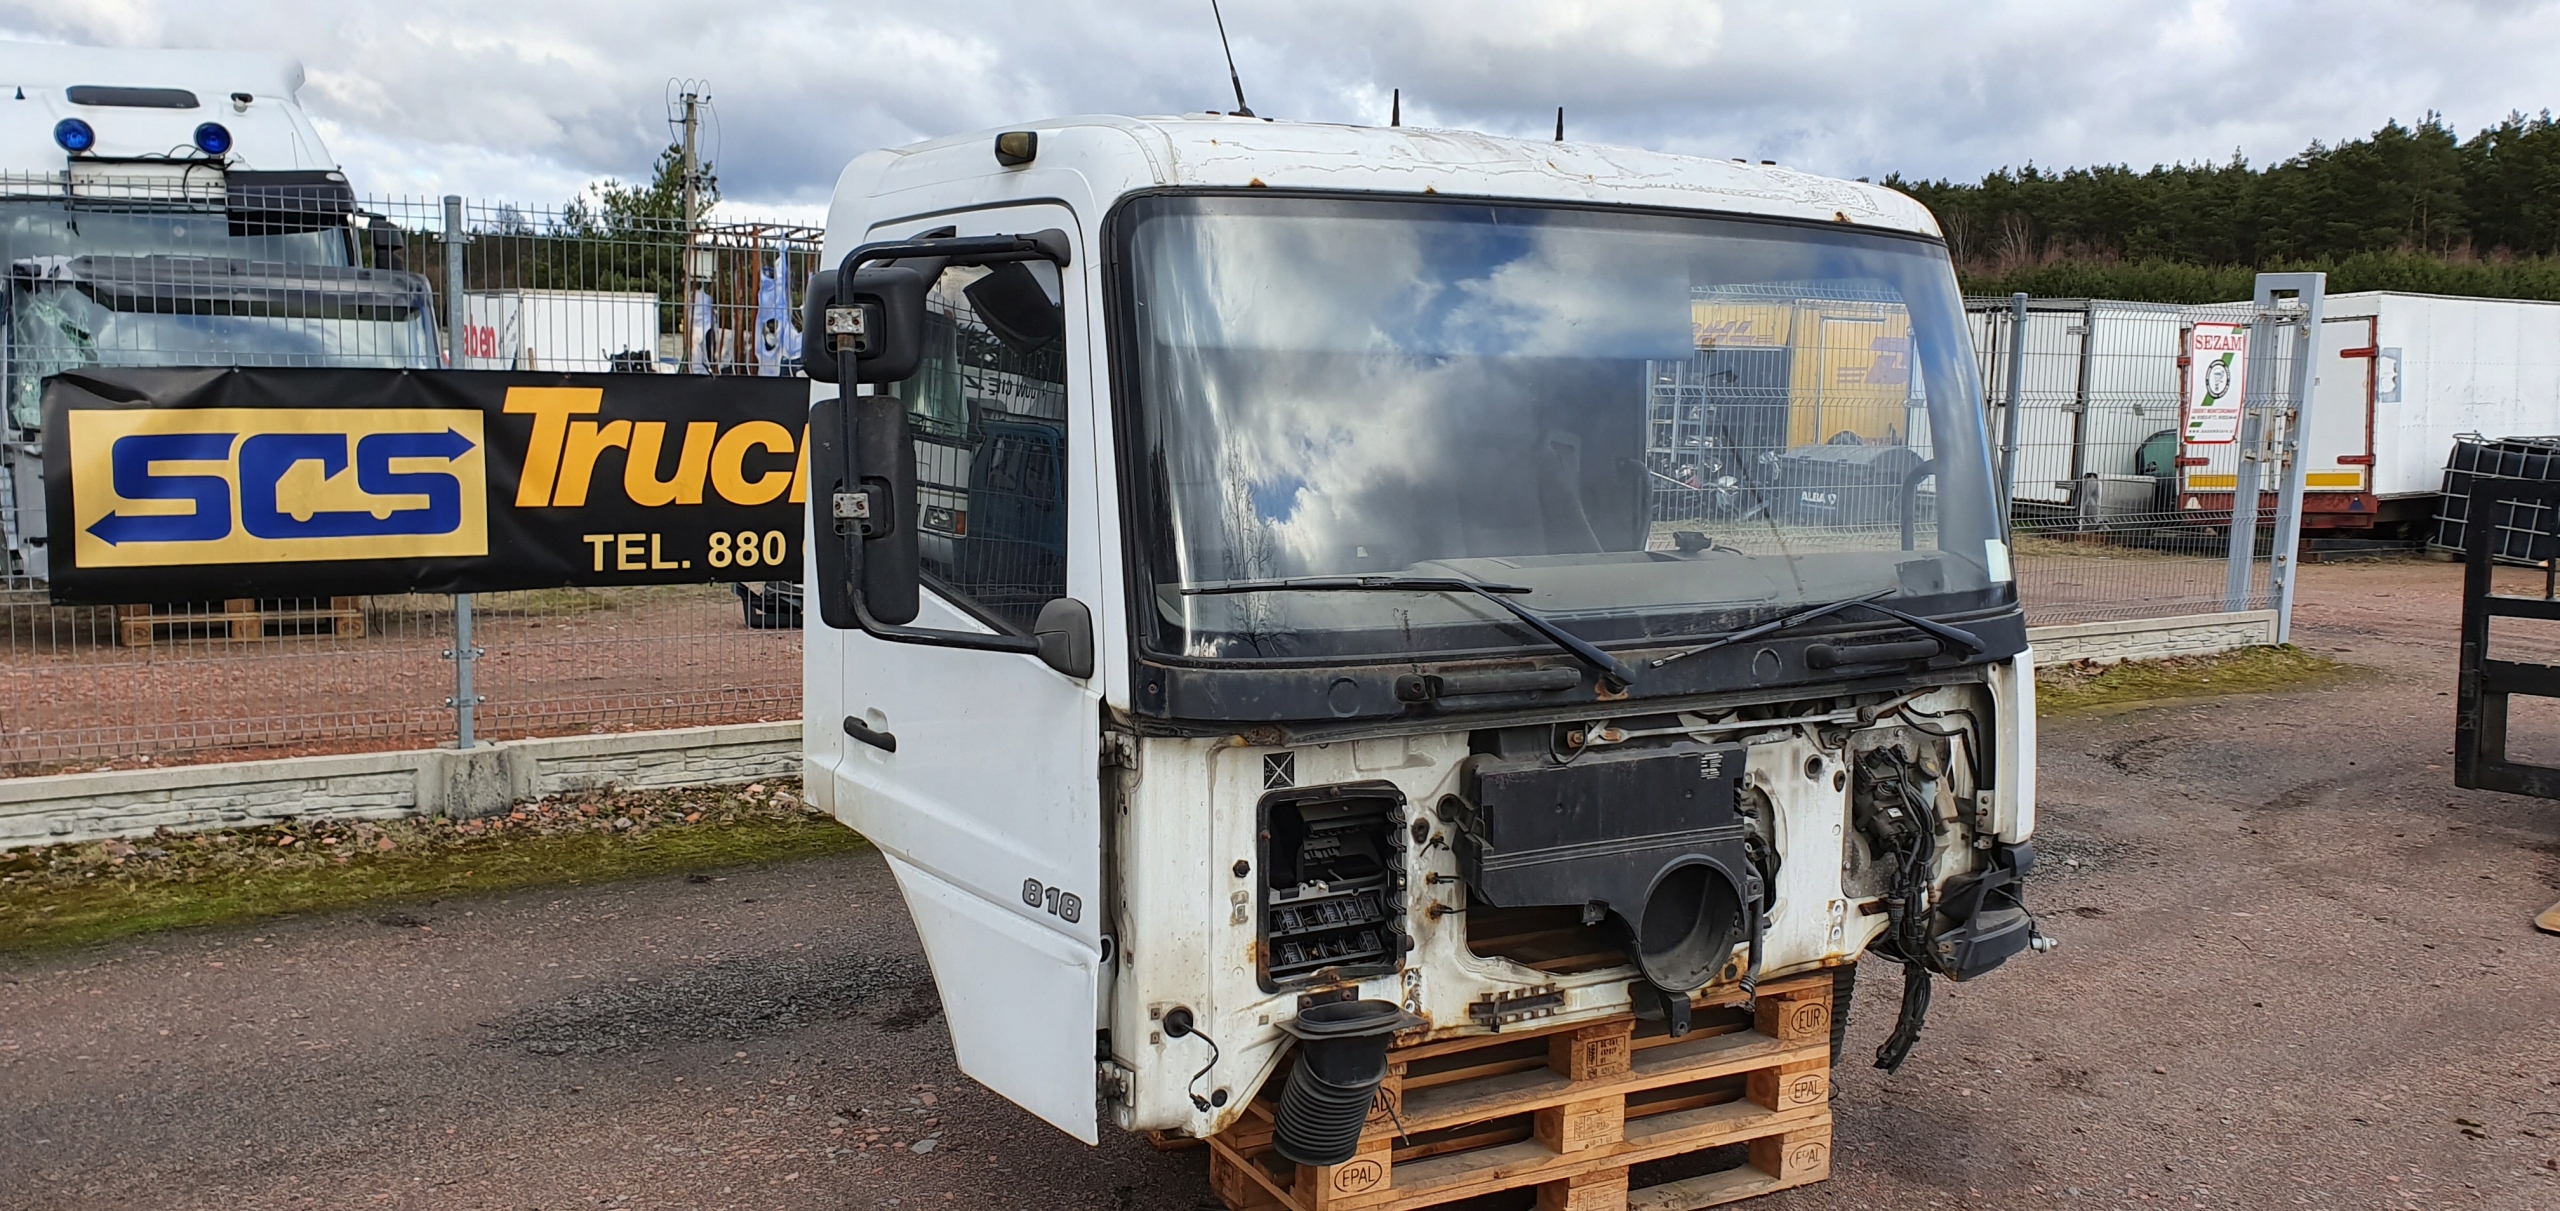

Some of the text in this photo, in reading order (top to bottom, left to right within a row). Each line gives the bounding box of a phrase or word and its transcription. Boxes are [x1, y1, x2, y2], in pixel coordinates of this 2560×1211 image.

[2195, 334, 2242, 351] SEZAM
[502, 386, 811, 507] Truc
[86, 427, 477, 547] SCS
[582, 532, 691, 572] TEL.
[708, 529, 787, 569] 880
[1022, 877, 1083, 924] 818
[1799, 1008, 1821, 1030] EUR
[1794, 1080, 1821, 1099] EPAL
[1342, 1165, 1377, 1188] EPAL
